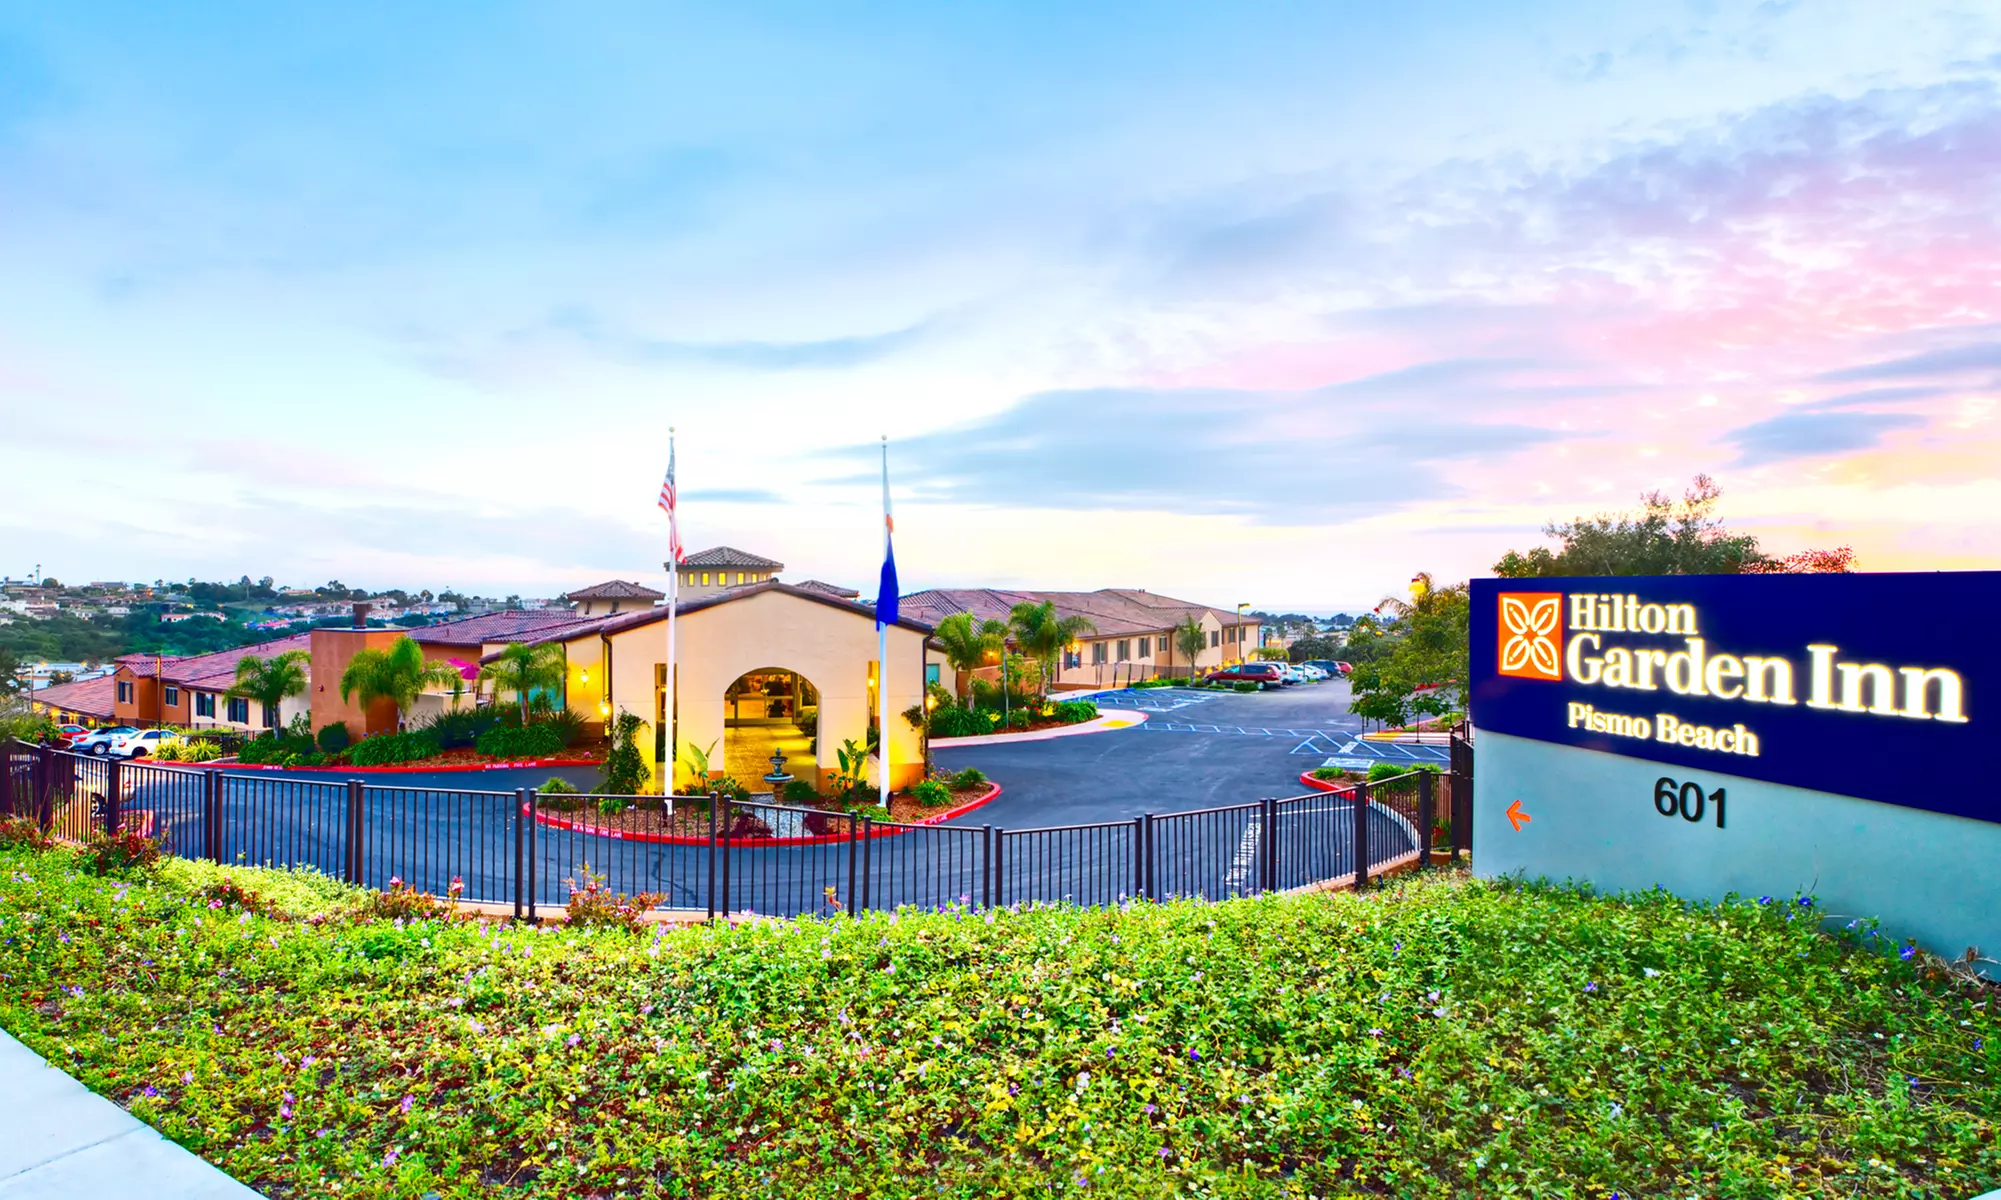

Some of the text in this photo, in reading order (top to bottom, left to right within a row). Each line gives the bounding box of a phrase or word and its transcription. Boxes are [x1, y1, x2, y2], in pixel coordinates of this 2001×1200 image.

[1568, 593, 1699, 636] Hilton
[1566, 632, 1969, 723] Garden Inn
[1567, 702, 1760, 757] Pismo Beach
[1654, 777, 1727, 829] 601
